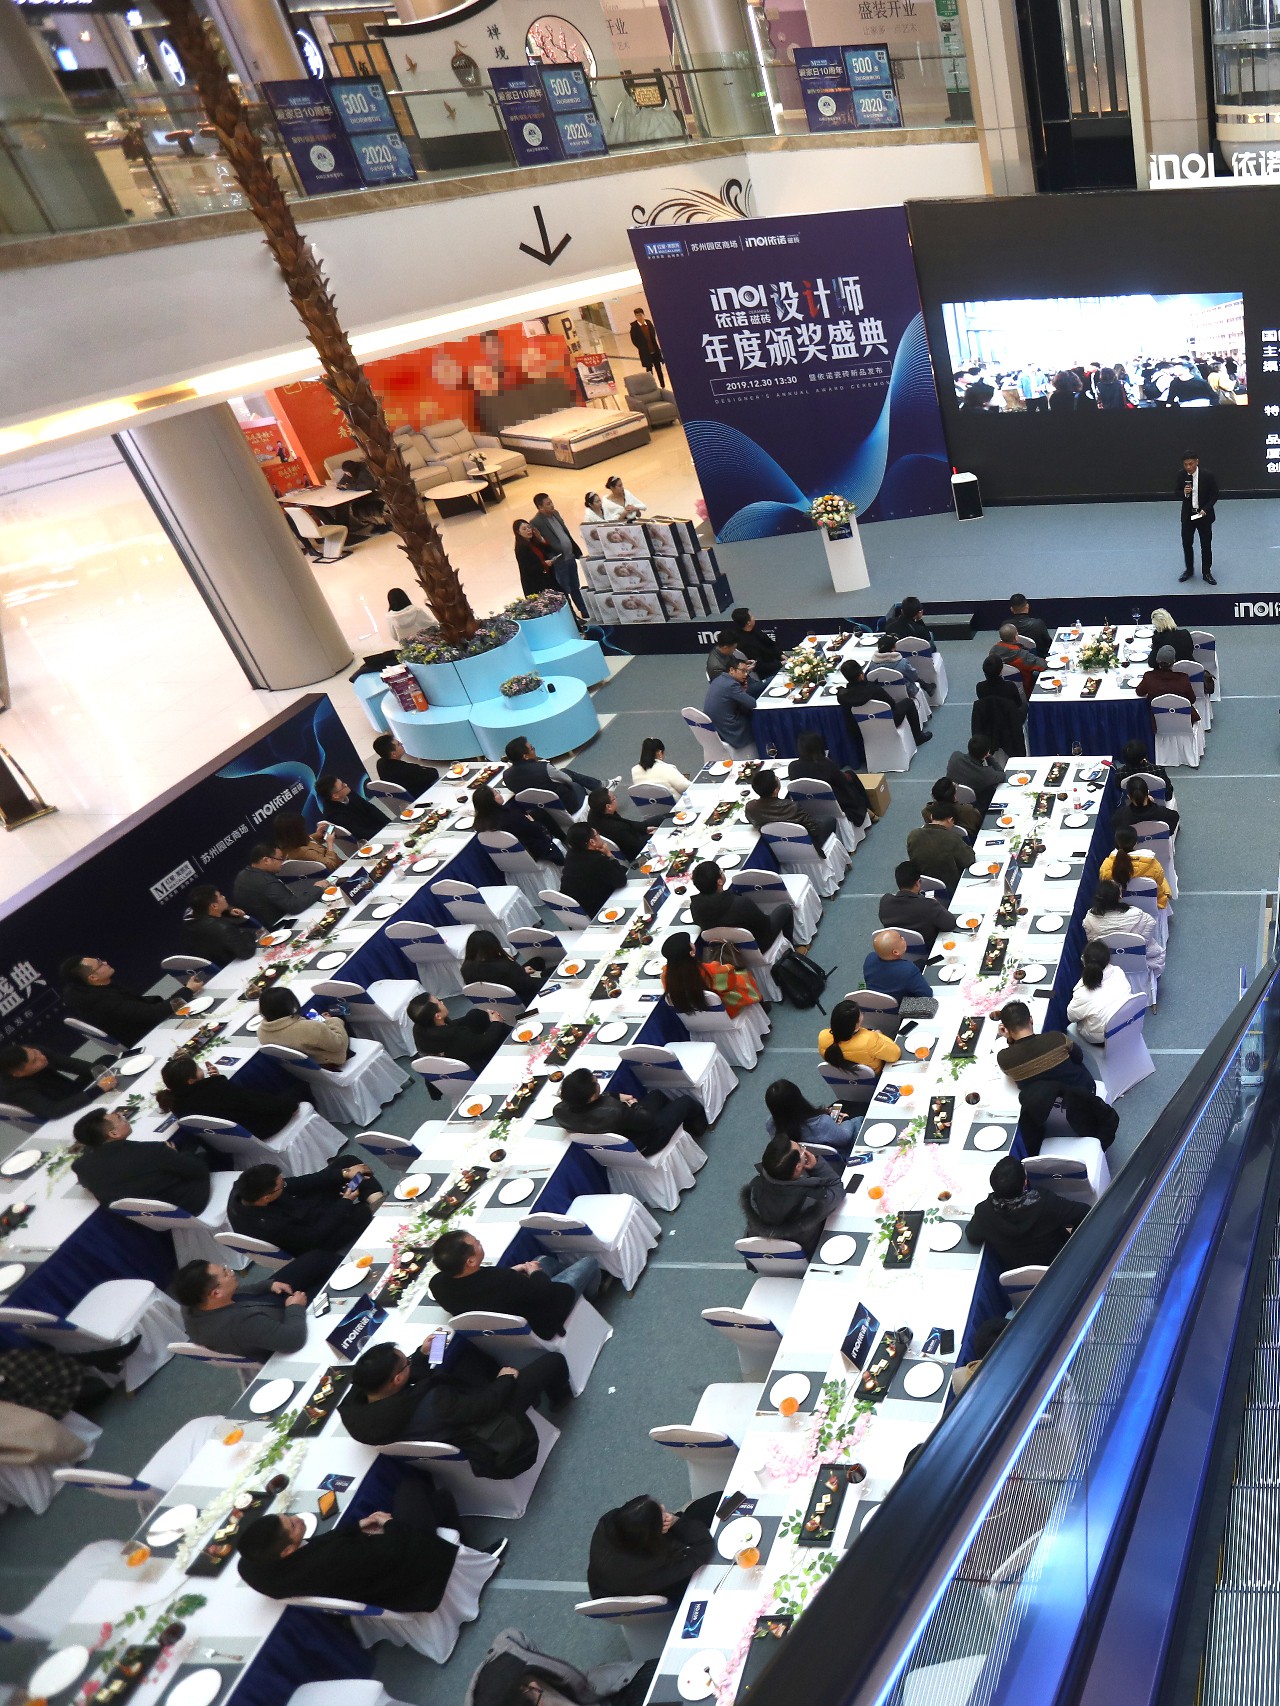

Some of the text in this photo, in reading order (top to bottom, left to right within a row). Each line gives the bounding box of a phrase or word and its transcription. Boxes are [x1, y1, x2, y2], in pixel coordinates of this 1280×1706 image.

[858, 0, 918, 20] 盛装开业
[852, 57, 873, 74] 500
[550, 77, 572, 97] 500
[341, 93, 369, 115] 500
[859, 98, 883, 113] 2020
[564, 123, 588, 140] 2020
[362, 145, 392, 165] 2020
[770, 275, 864, 323] 设计师
[701, 317, 889, 373] 年度颁奖盛典
[726, 377, 773, 391] 2019.12.30
[774, 376, 798, 387] 13:30
[200, 823, 249, 865] 苏州园区商场
